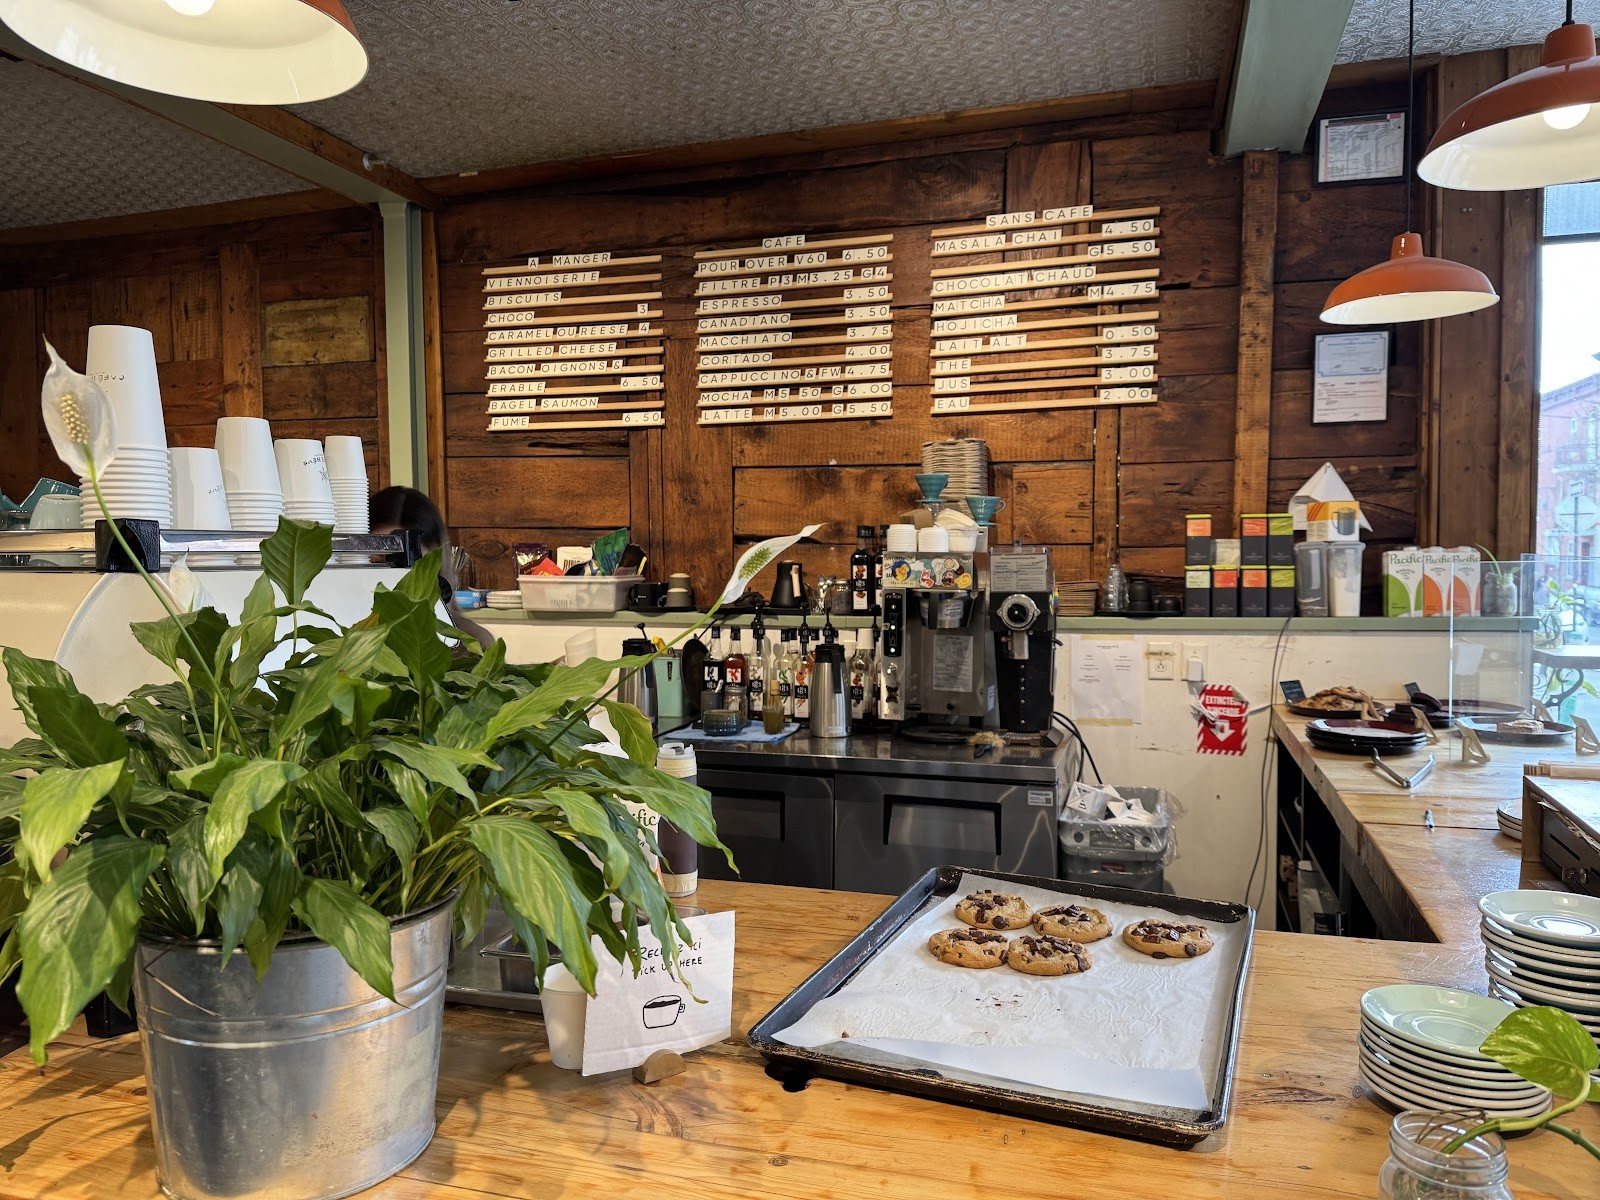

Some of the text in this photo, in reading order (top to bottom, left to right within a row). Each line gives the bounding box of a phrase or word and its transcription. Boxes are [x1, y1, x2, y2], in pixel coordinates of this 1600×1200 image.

[989, 206, 1091, 227] SANS CAFE
[763, 236, 804, 249] CAFE
[936, 220, 1152, 252] MASALA CHAI 4.50
[529, 253, 609, 268] A MANGER
[699, 247, 886, 273] POUR OVER V60 6.50
[488, 272, 597, 288] VIENNOISERIE
[701, 278, 759, 292] FILTRE
[934, 267, 1095, 292] CHOCOLAT CHAUD
[488, 292, 560, 306] BISCUITS
[702, 286, 886, 311] ESPRESSO 3.50
[934, 297, 1003, 313] MATCHA
[488, 304, 646, 324] CHOCO 3
[699, 306, 887, 329] CANADIANO 3.50
[488, 323, 648, 341] CARAMEL OU REESE 4
[936, 316, 1015, 332] HOJICHA
[700, 325, 889, 347] MACCHIATO 3.75
[938, 326, 1153, 352] LAIT ALT 0.50
[489, 343, 615, 358] GRILLED CHEESE
[701, 345, 888, 366] CORTADO 4.00
[939, 346, 1151, 370] THE 3.75
[490, 360, 622, 376] BACON OIGNONS &
[700, 364, 887, 384] CAPPUCCINO & FW 4.75
[491, 376, 659, 393] ERABLE 6.50
[937, 367, 1151, 390] JUS 3.00
[491, 397, 598, 411] BAGEL SAUMON
[701, 391, 750, 403] MOCHA
[937, 388, 1149, 409] EAU 2.00
[493, 412, 660, 427] FUME 6.50
[703, 409, 750, 421] LATTE
[1390, 553, 1424, 565] Pacific
[1425, 554, 1452, 564] Pacific
[1205, 695, 1243, 706] EXTINCTE
[679, 956, 703, 968] HERE
